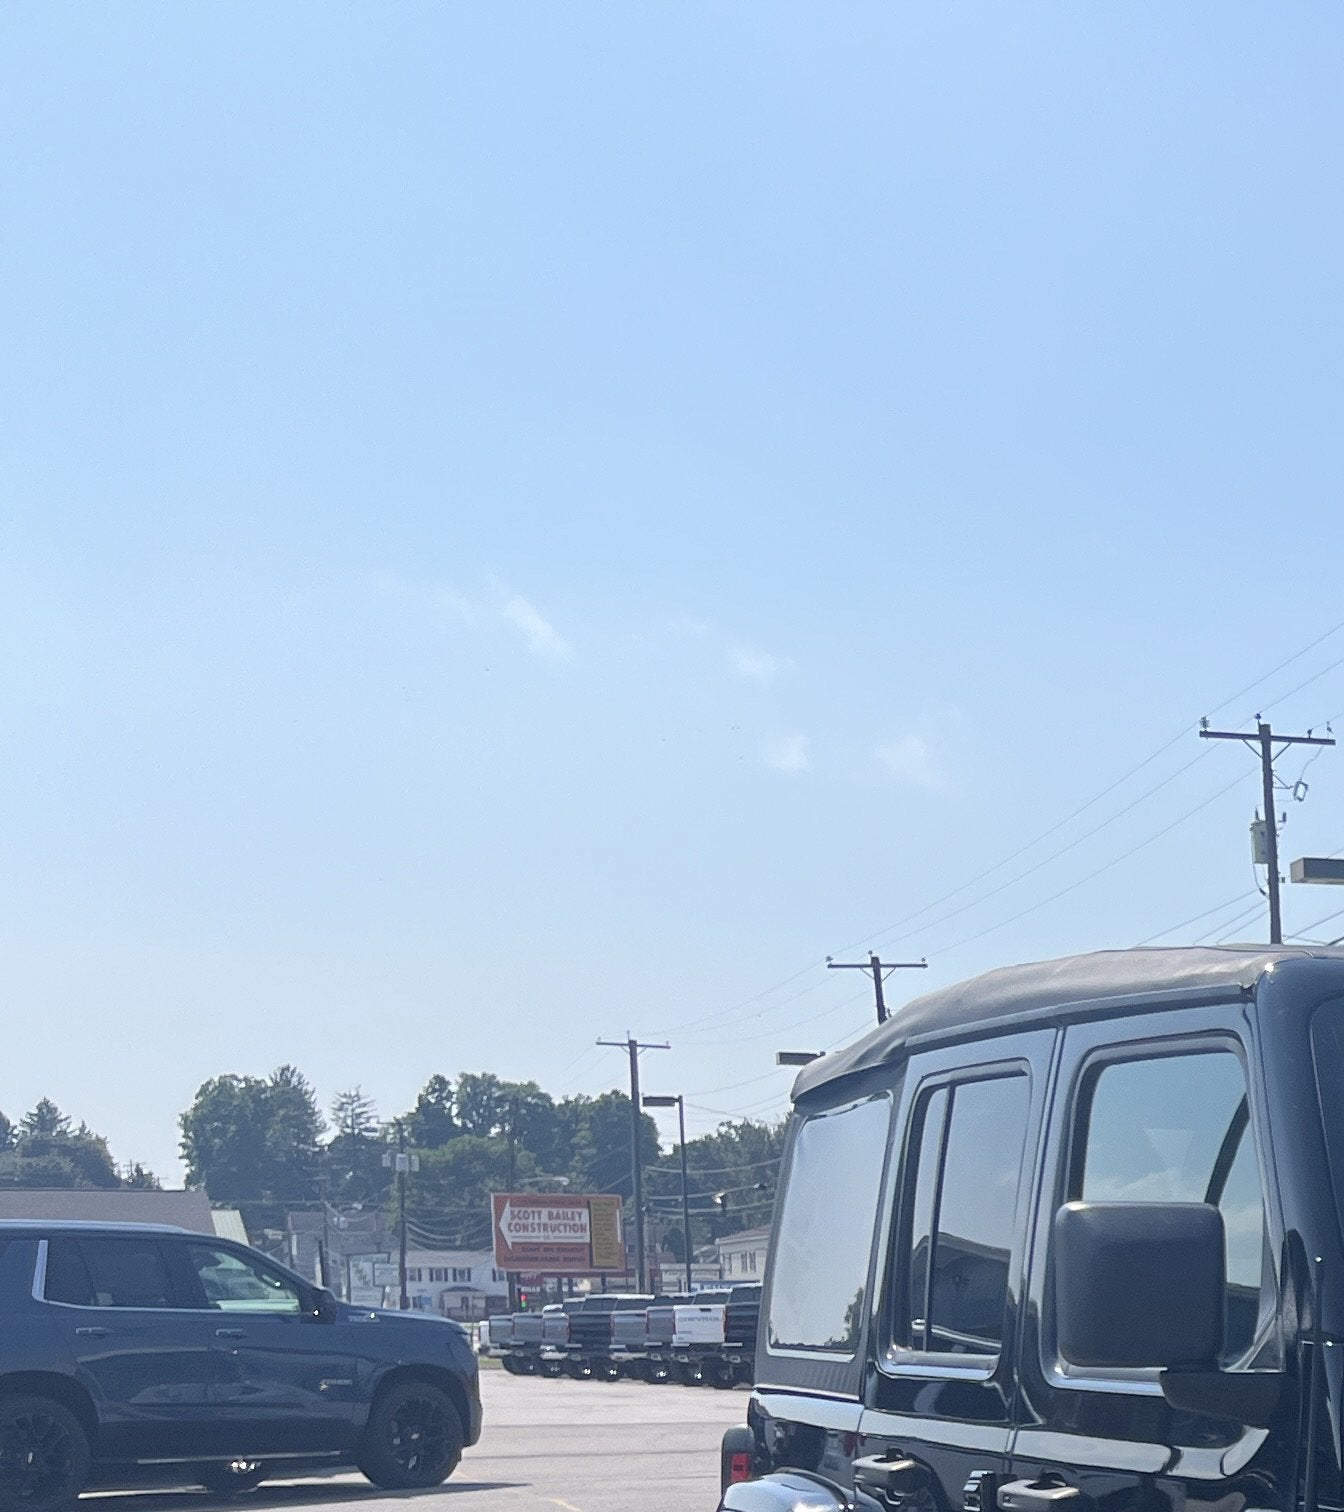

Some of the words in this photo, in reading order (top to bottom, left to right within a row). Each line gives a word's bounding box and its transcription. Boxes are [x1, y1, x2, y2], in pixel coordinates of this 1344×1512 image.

[510, 1209, 543, 1221] SCOTT
[547, 1210, 584, 1222] BAILEY
[507, 1221, 588, 1234] CONSTRUCTION
